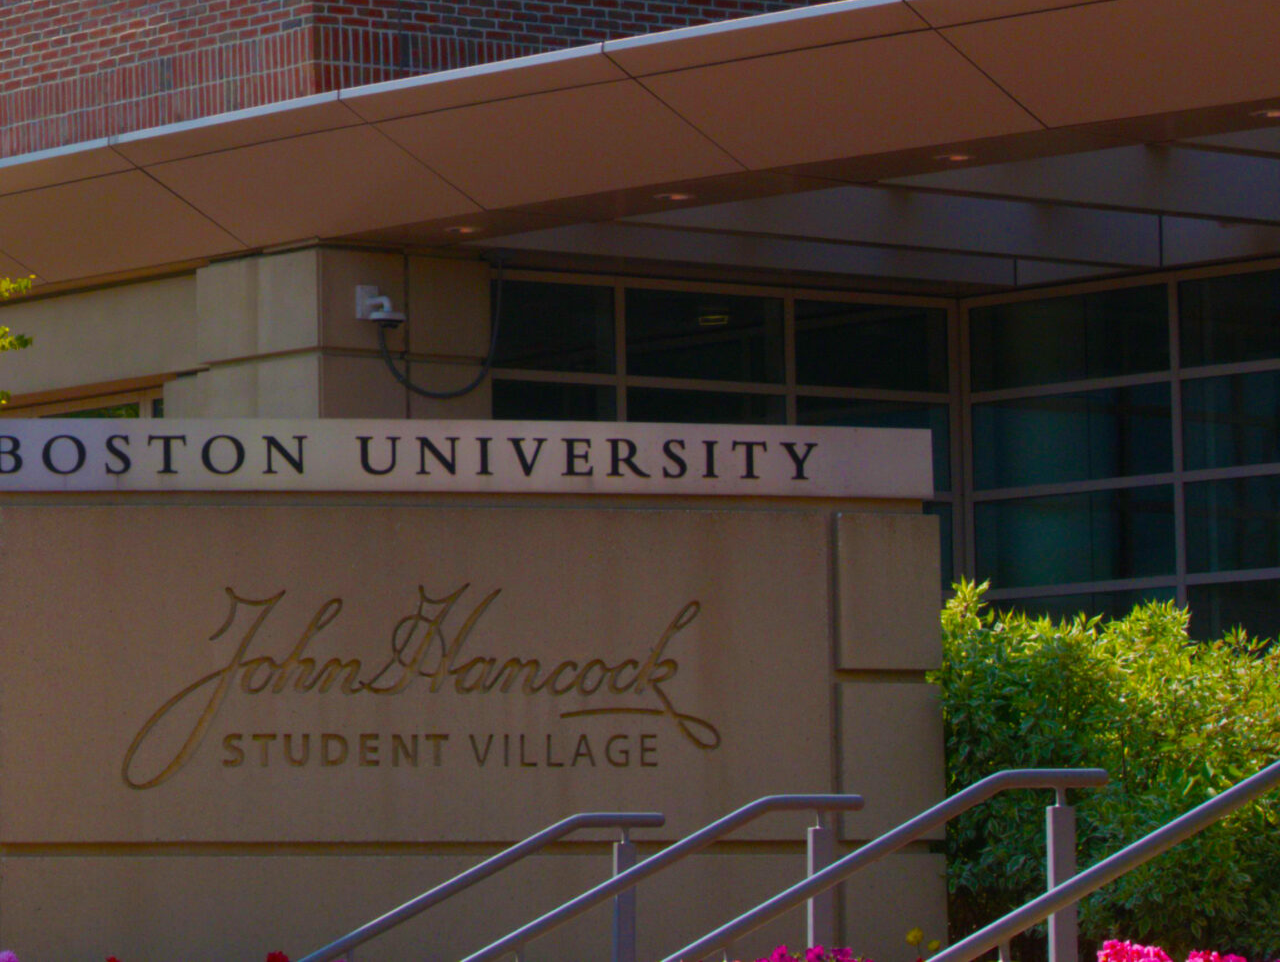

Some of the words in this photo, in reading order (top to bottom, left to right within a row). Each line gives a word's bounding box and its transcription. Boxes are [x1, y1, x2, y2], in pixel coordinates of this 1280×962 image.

[355, 435, 819, 481] UNIVERSITY
[122, 585, 363, 791] John
[358, 582, 721, 751] Hancock
[221, 732, 449, 769] STUDENT
[468, 732, 660, 768] VILLAGE
